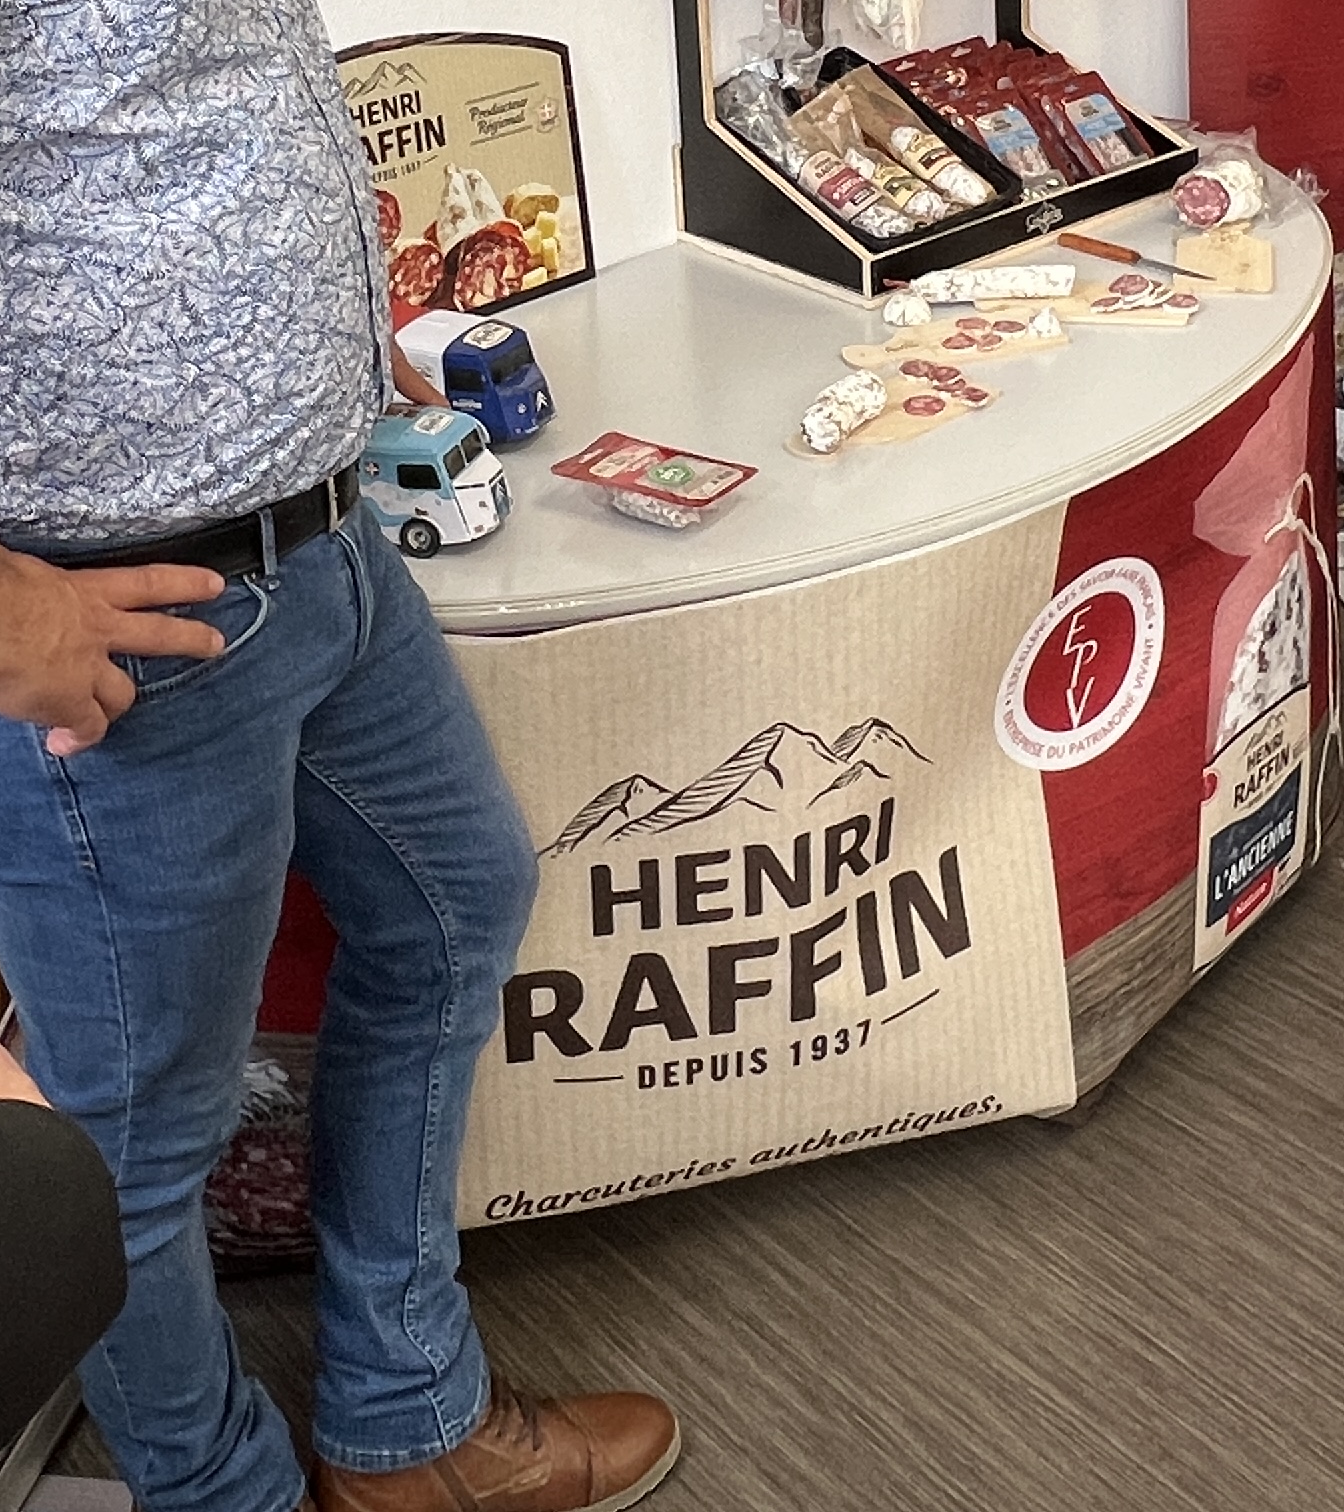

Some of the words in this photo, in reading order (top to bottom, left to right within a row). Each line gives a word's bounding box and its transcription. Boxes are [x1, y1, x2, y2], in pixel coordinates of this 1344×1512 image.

[349, 90, 422, 128] HENRI
[360, 114, 447, 166] AFFIN
[1047, 744, 1066, 759] DU
[590, 796, 895, 938] HENRI
[502, 846, 972, 1065] RAFFIN
[638, 1047, 769, 1090] DEPUIS
[790, 1019, 873, 1068] 1937
[484, 1155, 737, 1221] Charcuteries
[749, 1095, 1004, 1168] authentiques,
